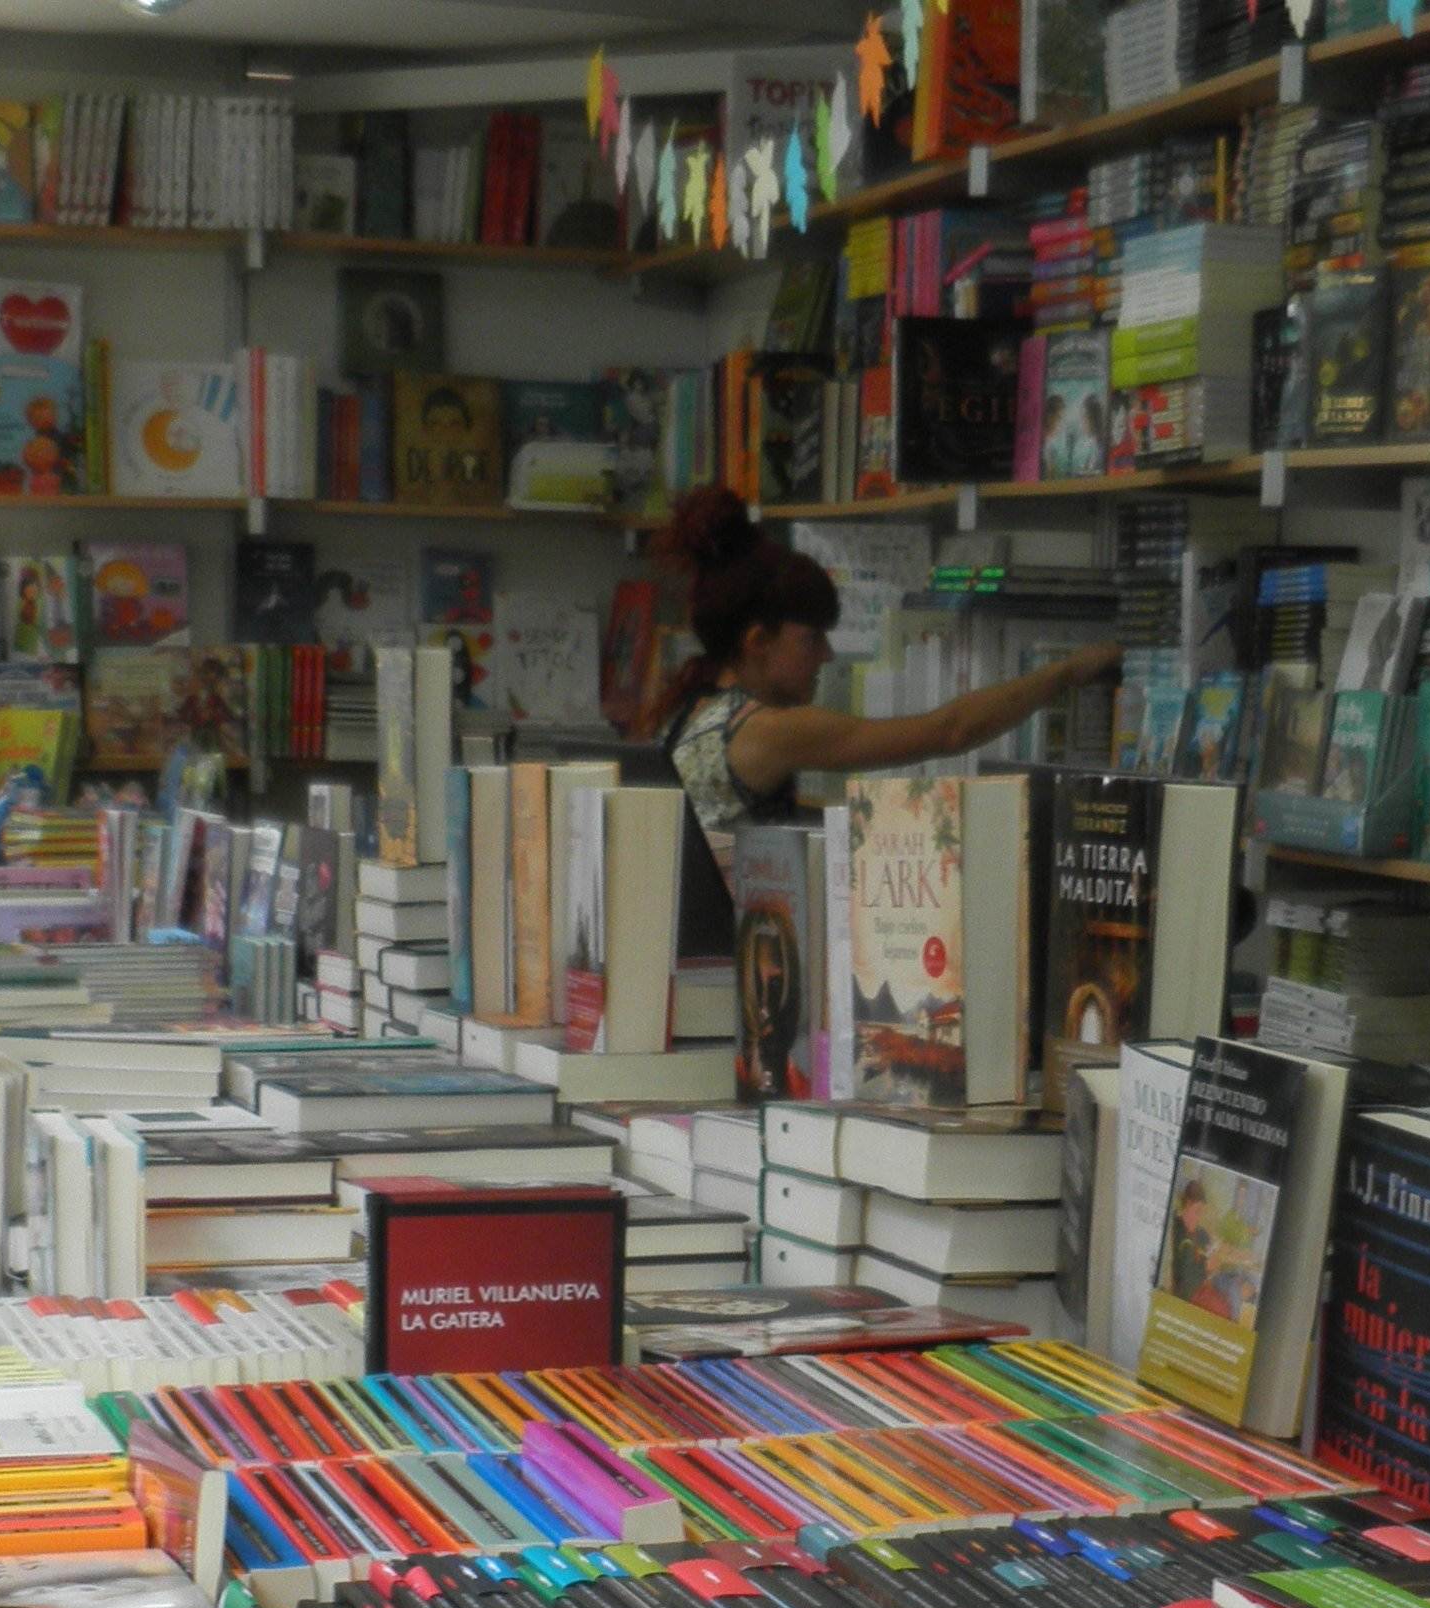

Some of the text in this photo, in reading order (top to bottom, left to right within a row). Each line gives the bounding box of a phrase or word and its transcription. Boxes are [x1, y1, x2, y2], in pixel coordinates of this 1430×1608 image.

[1054, 841, 1148, 875] LA TIERRA
[859, 859, 942, 909] LARK
[1058, 875, 1139, 907] MALDITA
[400, 1282, 601, 1306] MURIEL VILLANUEVA
[400, 1311, 505, 1331] LA GATERA
